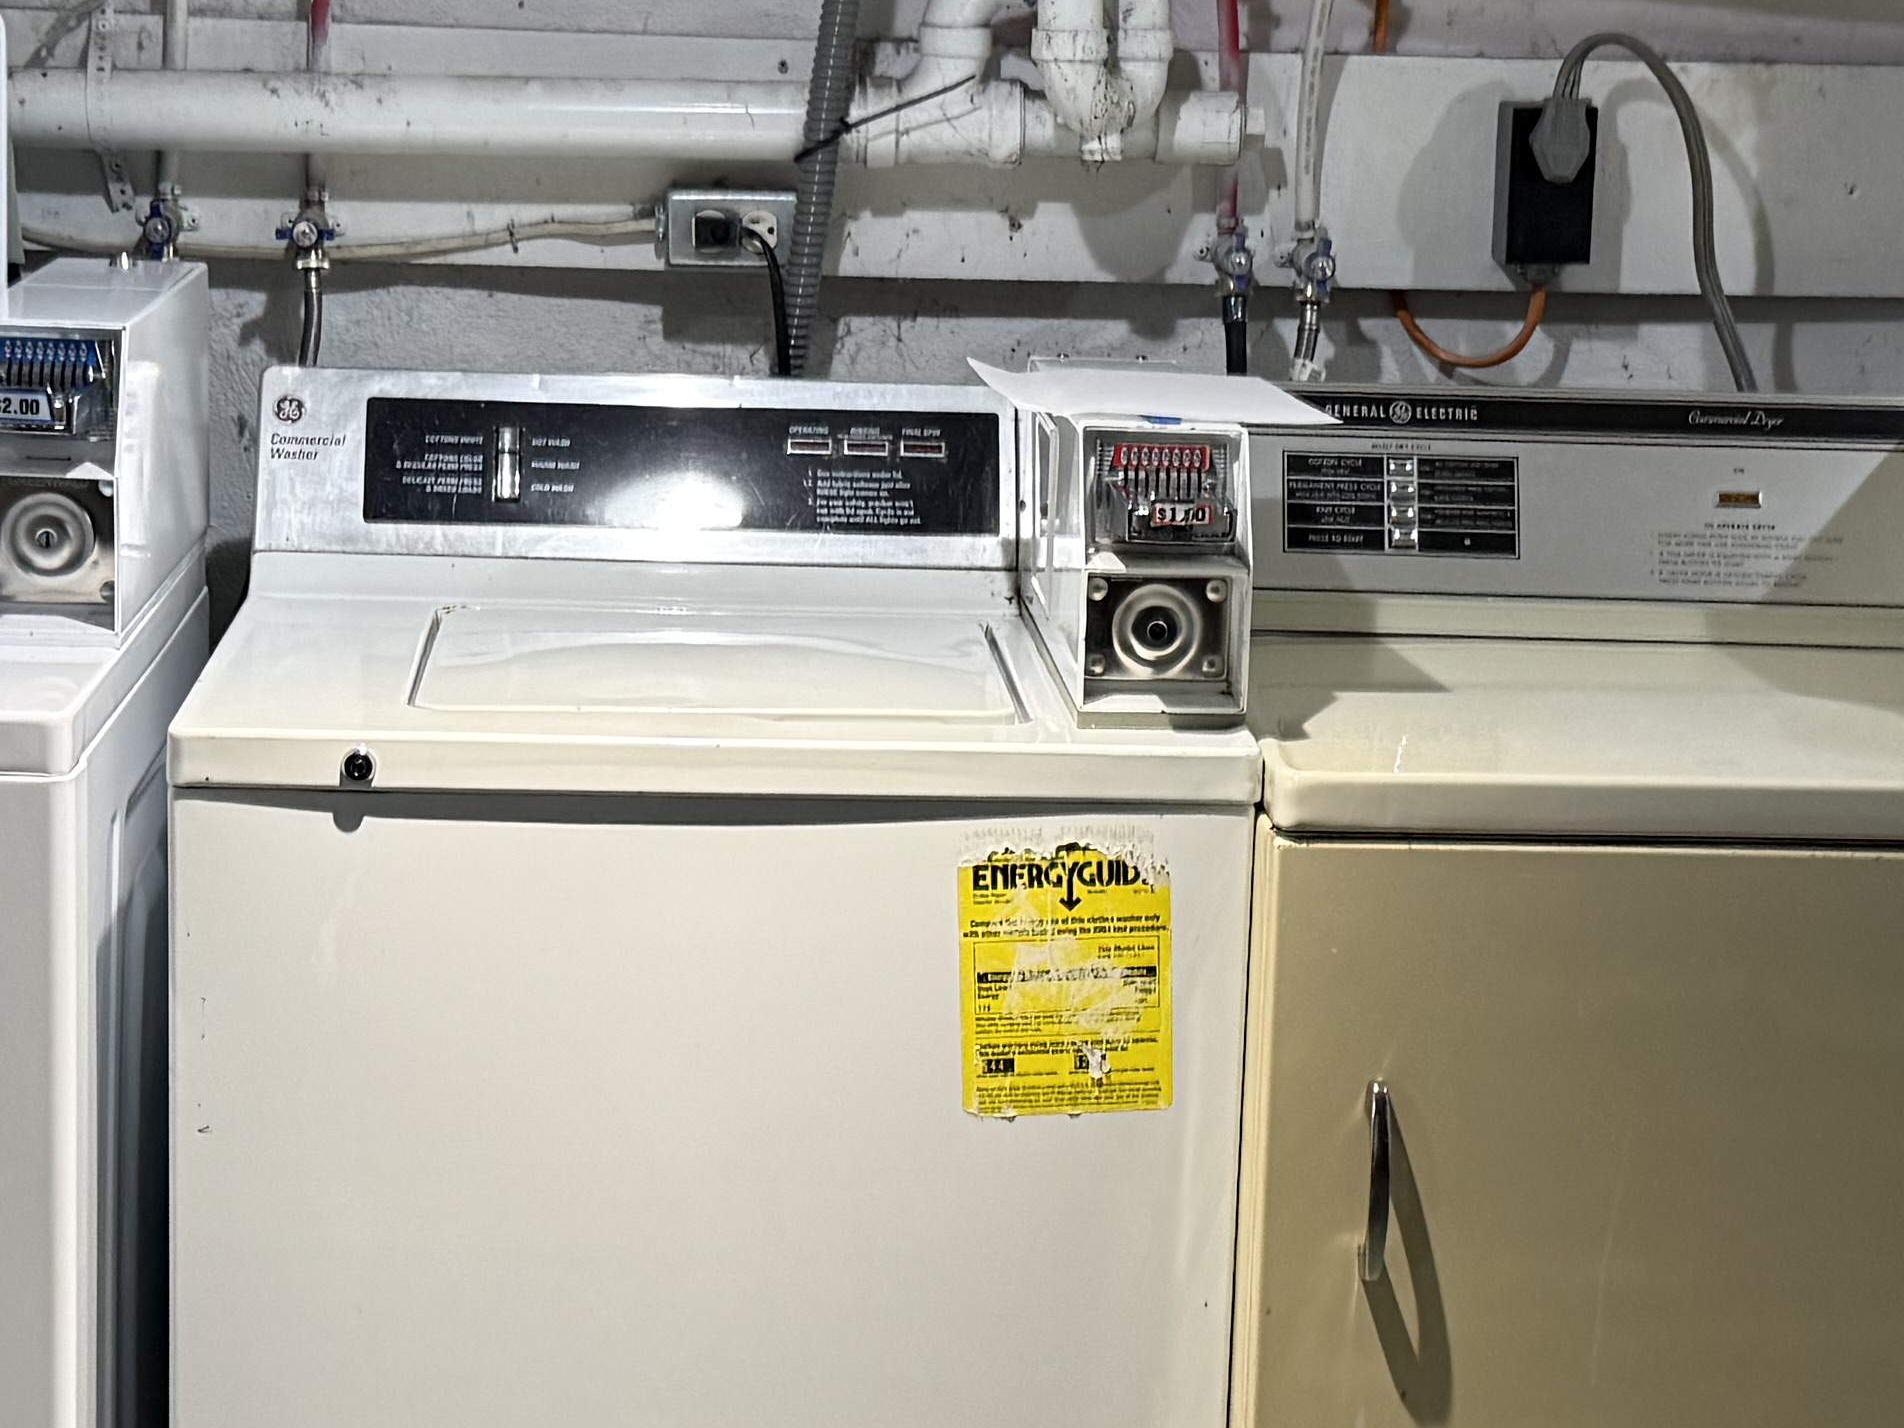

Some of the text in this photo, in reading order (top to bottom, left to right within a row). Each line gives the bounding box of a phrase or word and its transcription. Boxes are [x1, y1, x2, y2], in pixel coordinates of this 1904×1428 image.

[1416, 405, 1478, 422] ELECTRIC
[1750, 410, 1786, 432] Dryer
[270, 433, 346, 448] Commercial
[270, 448, 319, 460] Washer
[972, 860, 1150, 893] ENERGYGUID
